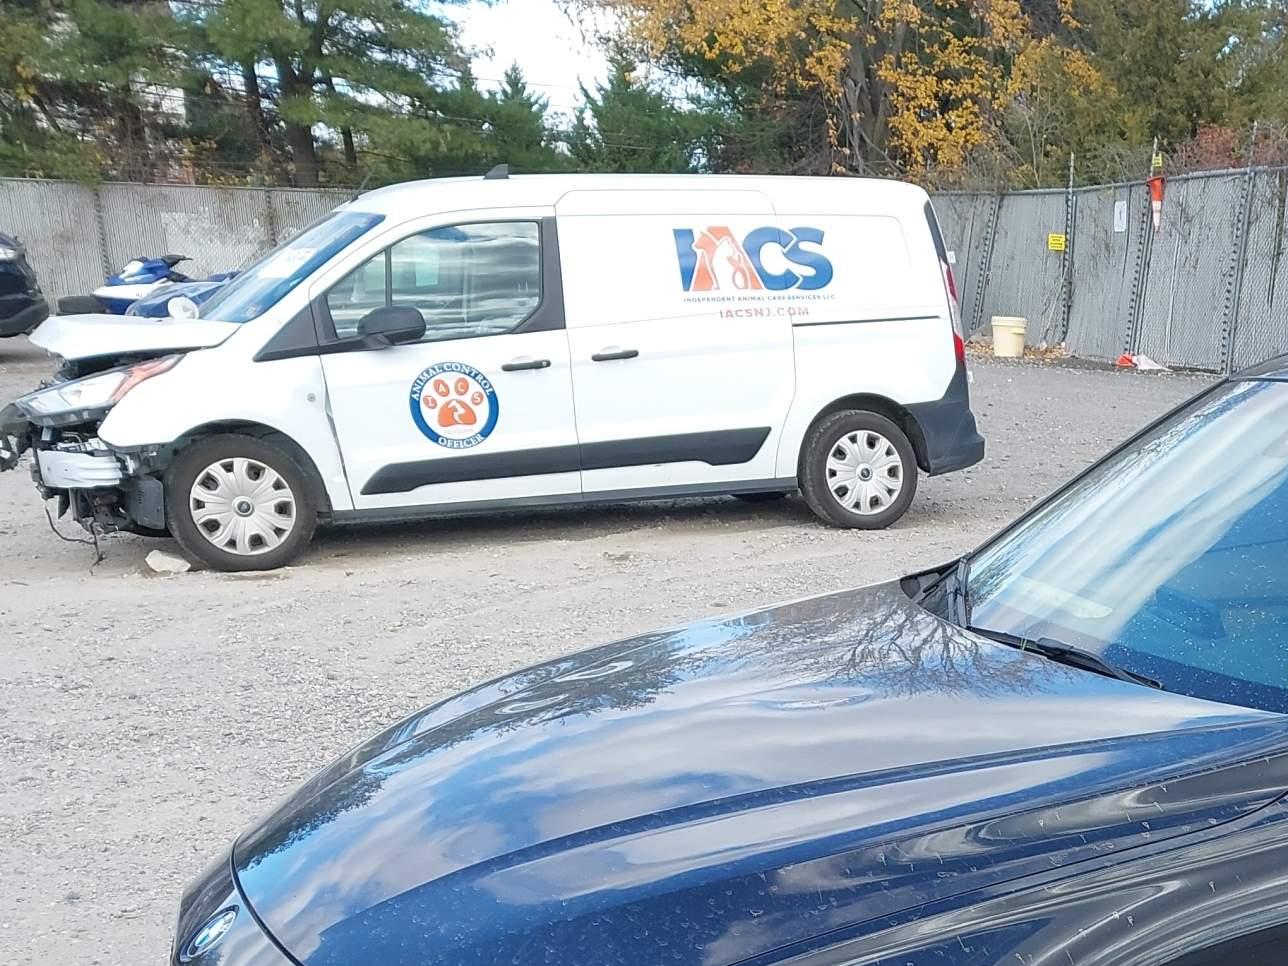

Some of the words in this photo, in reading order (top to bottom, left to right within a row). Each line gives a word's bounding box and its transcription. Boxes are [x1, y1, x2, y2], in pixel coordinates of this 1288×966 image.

[672, 226, 834, 292] IACS
[719, 306, 809, 319] IACSNJ.COM
[411, 365, 443, 401] ANIMAL
[443, 362, 495, 396] CONTROL
[438, 433, 485, 449] OFFICER
